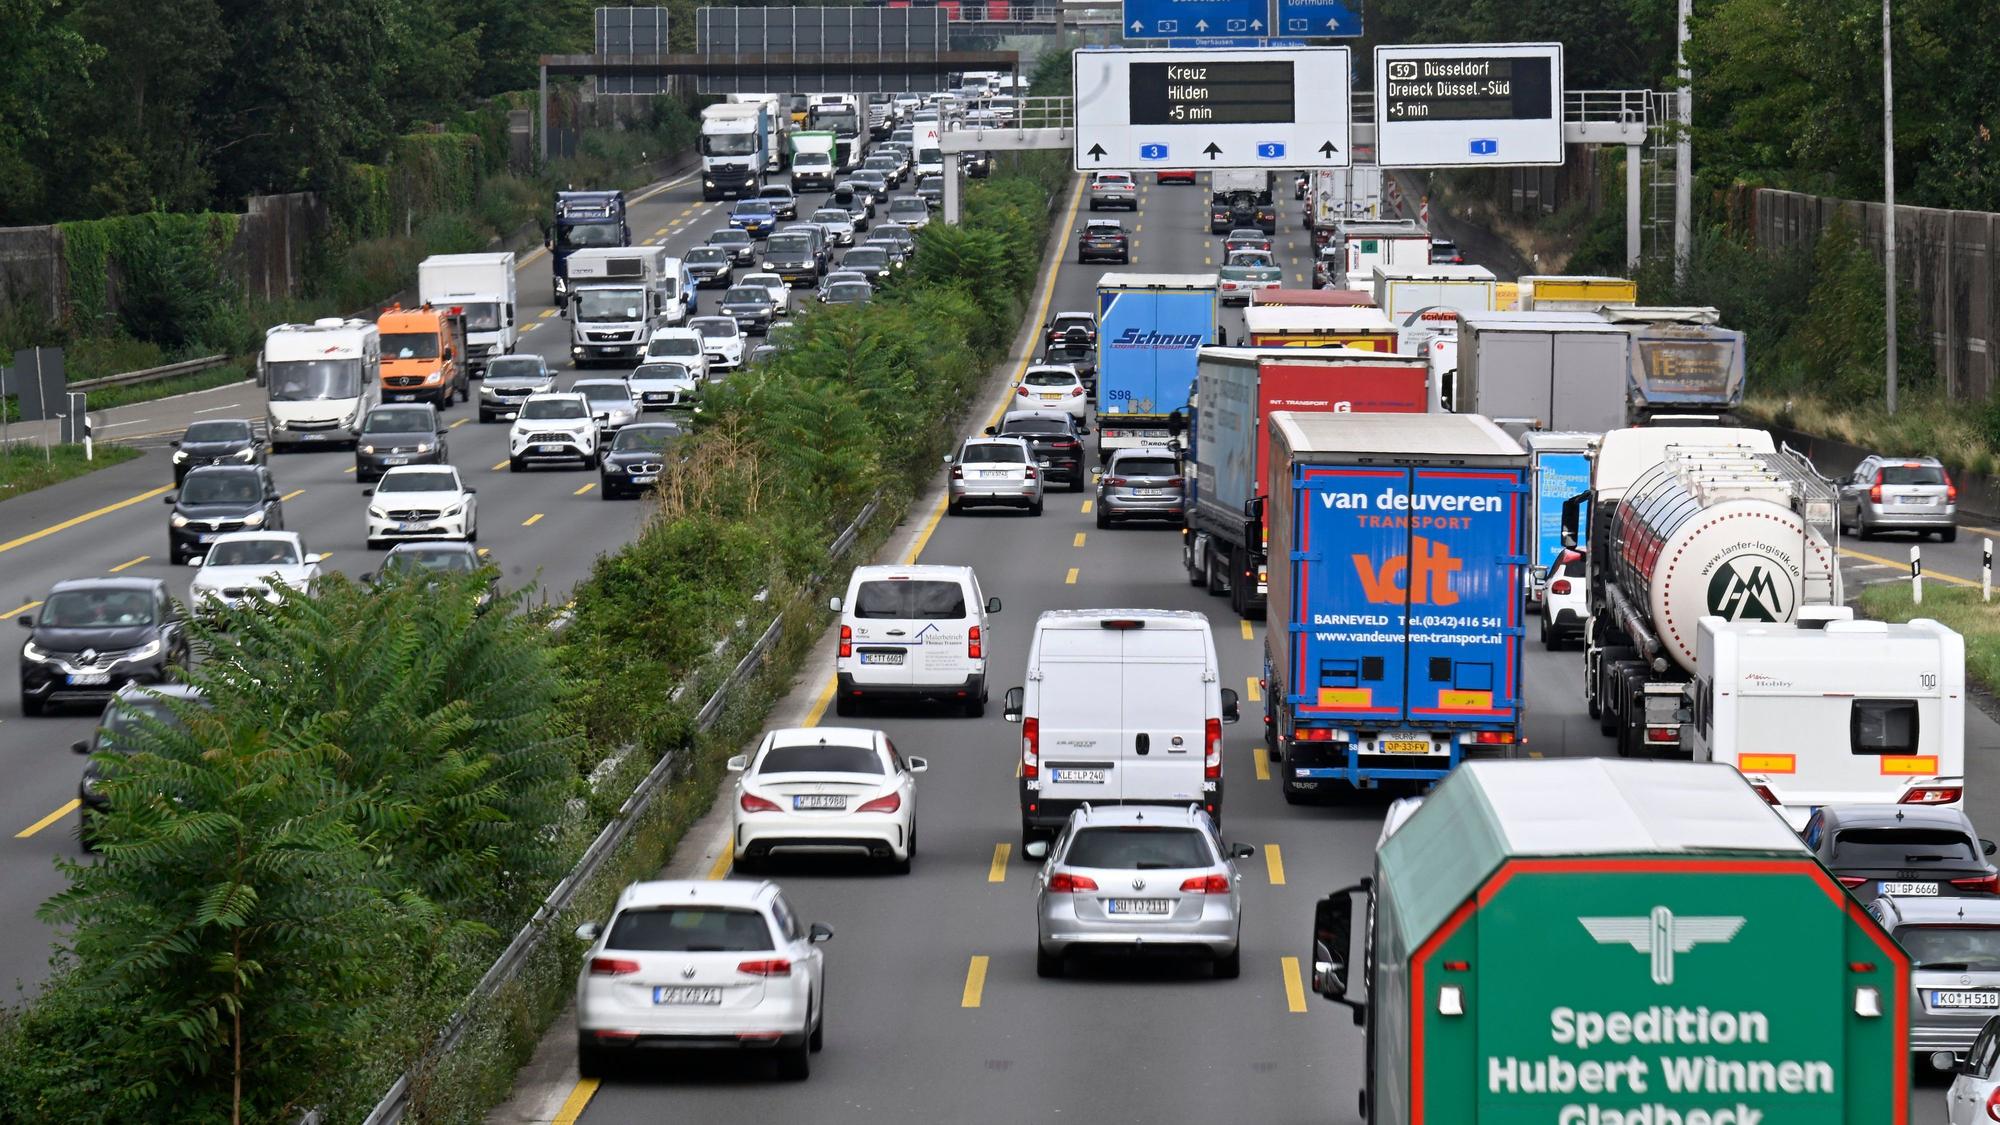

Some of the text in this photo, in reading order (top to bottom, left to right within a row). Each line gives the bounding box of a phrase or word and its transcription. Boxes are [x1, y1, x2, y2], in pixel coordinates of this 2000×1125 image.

[1167, 66, 1207, 80] Kreuz
[1396, 61, 1490, 77] 59 Düsseldorf
[1168, 86, 1209, 100] Hilden
[1389, 80, 1510, 97] Dreieck Düssel.-Süd
[1169, 105, 1212, 120] +5 min
[1390, 102, 1429, 116] +5 min
[1112, 328, 1203, 351] Schnug
[1109, 390, 1132, 401] S98
[1321, 487, 1502, 512] van deuveren
[1356, 515, 1472, 529] TRANSPORT
[1701, 540, 1800, 578] www.lanfer-logistik.de
[1314, 614, 1389, 626] BARNEVELD
[1482, 617, 1502, 627] 541
[1919, 674, 1937, 688] 100
[1057, 770, 1104, 779] KLE LP 240
[1884, 883, 1938, 895] SU GP 6666
[1940, 993, 1956, 1004] KO
[1974, 993, 1997, 1005] 518
[1550, 1005, 1769, 1049] Spedition
[1488, 1054, 1835, 1094] Hubert Winnen
[1558, 1102, 1764, 1125] Gladbeck
